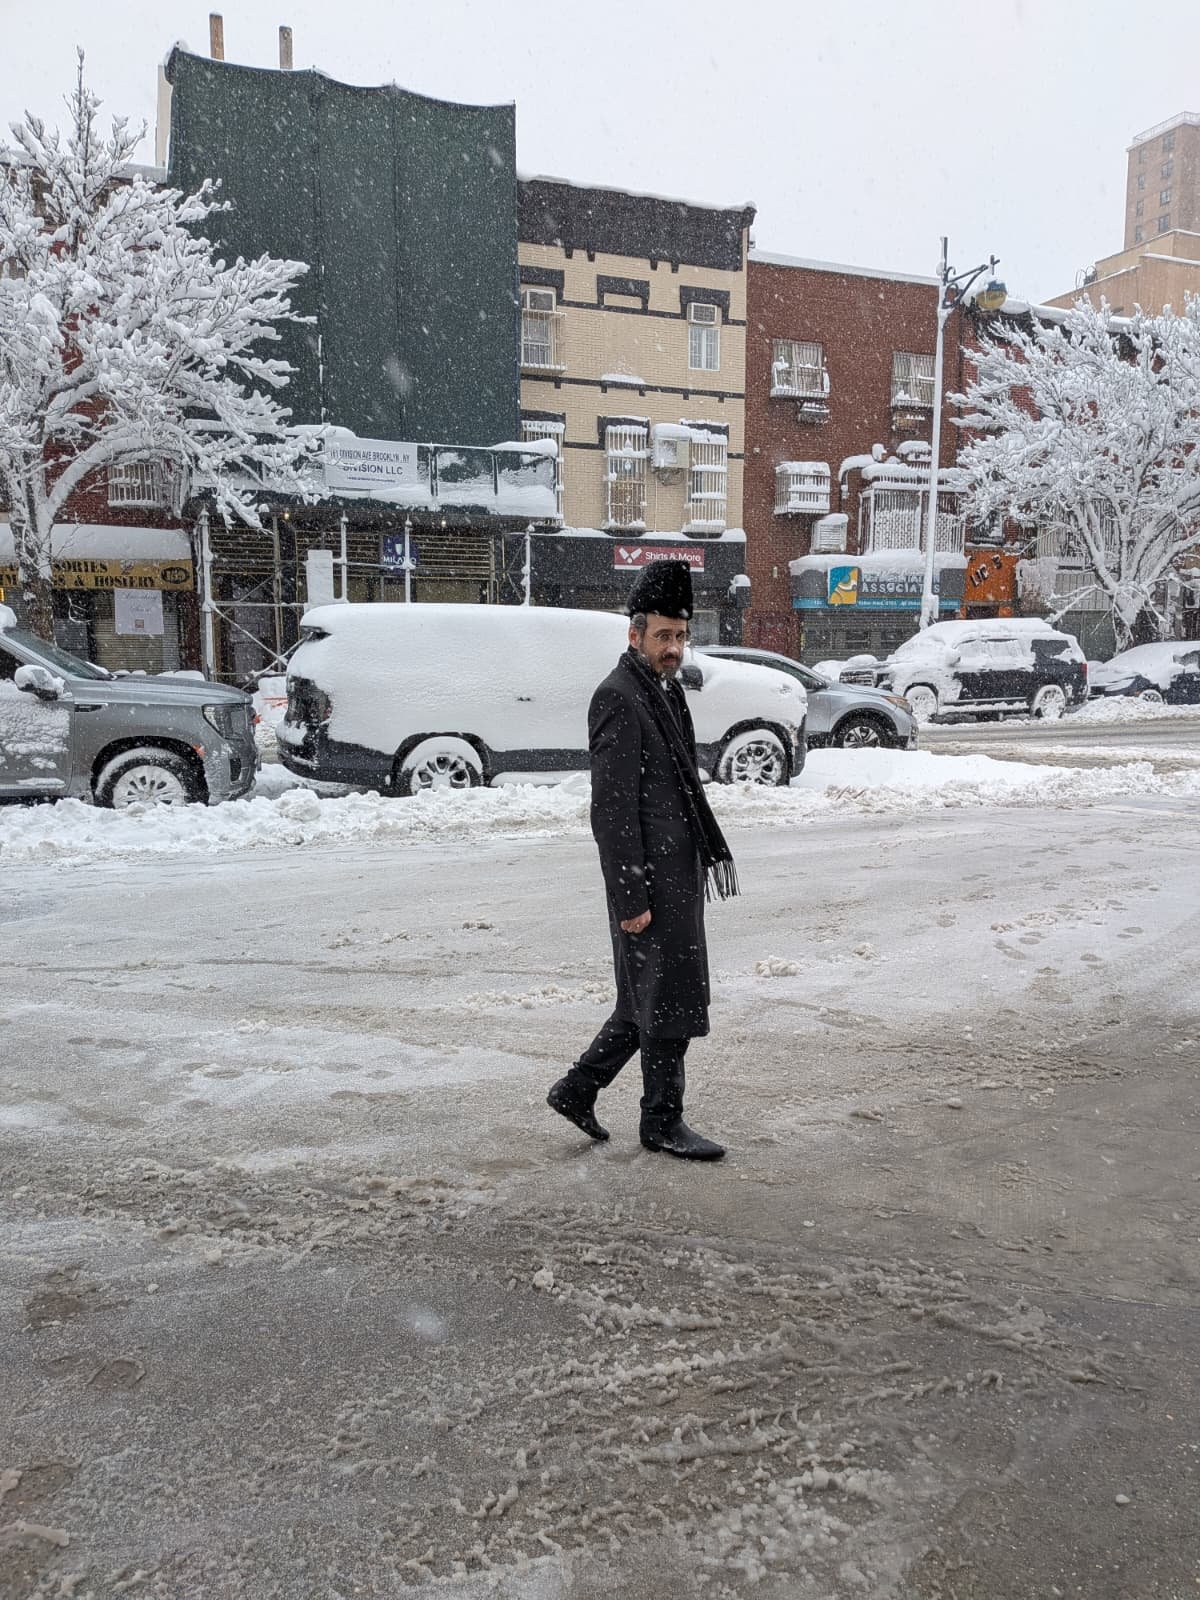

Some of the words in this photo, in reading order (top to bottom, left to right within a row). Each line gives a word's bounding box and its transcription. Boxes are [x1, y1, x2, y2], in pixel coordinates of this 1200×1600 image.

[372, 451, 399, 462] BROOKLYN
[386, 465, 403, 475] LLC
[383, 556, 417, 565] MILAO
[645, 551, 668, 560] Shirts
[669, 552, 677, 560] &
[678, 553, 701, 562] More
[74, 574, 85, 587] &
[94, 575, 156, 588] HOSIERY
[862, 582, 940, 593] ASSOCIATS
